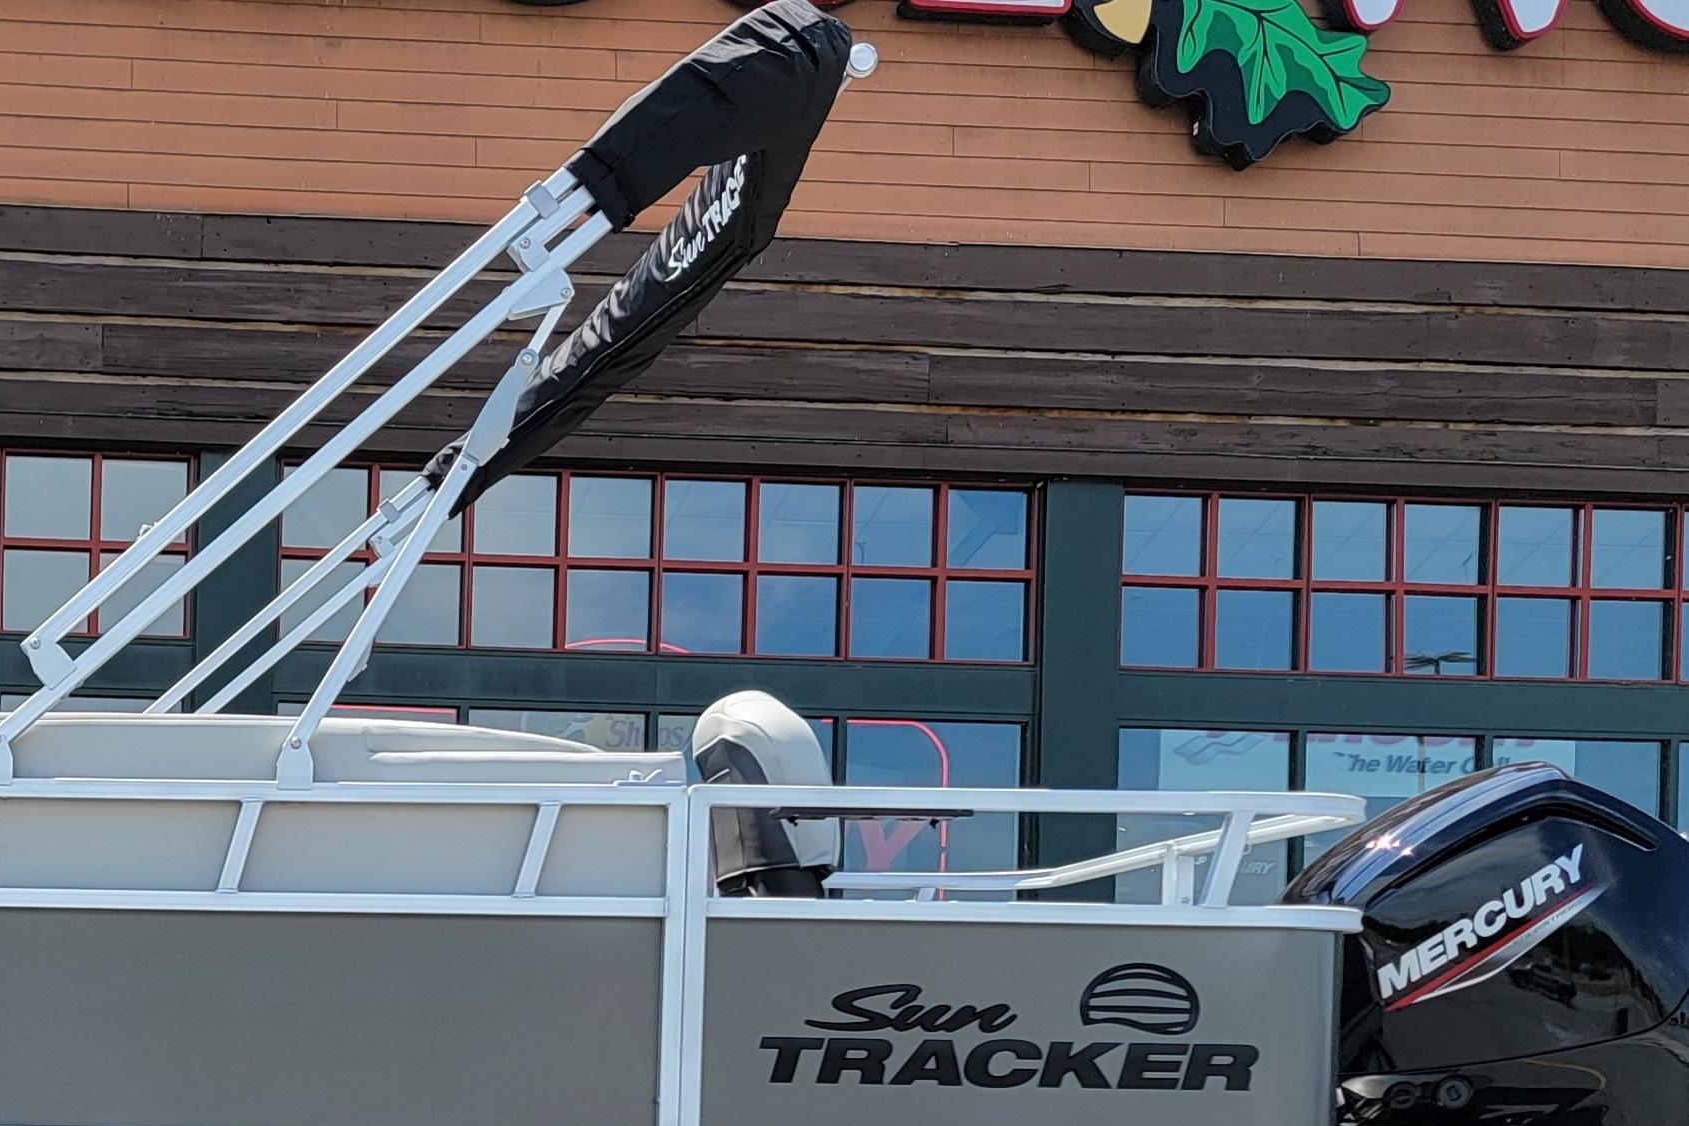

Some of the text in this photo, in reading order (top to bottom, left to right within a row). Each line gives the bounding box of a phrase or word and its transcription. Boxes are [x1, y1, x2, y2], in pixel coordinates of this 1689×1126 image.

[665, 231, 705, 282] Sun
[1386, 754, 1457, 775] Water
[1376, 843, 1583, 1000] MERCURY
[804, 983, 1018, 1033] Sun
[758, 1035, 1261, 1092] TRACKER
